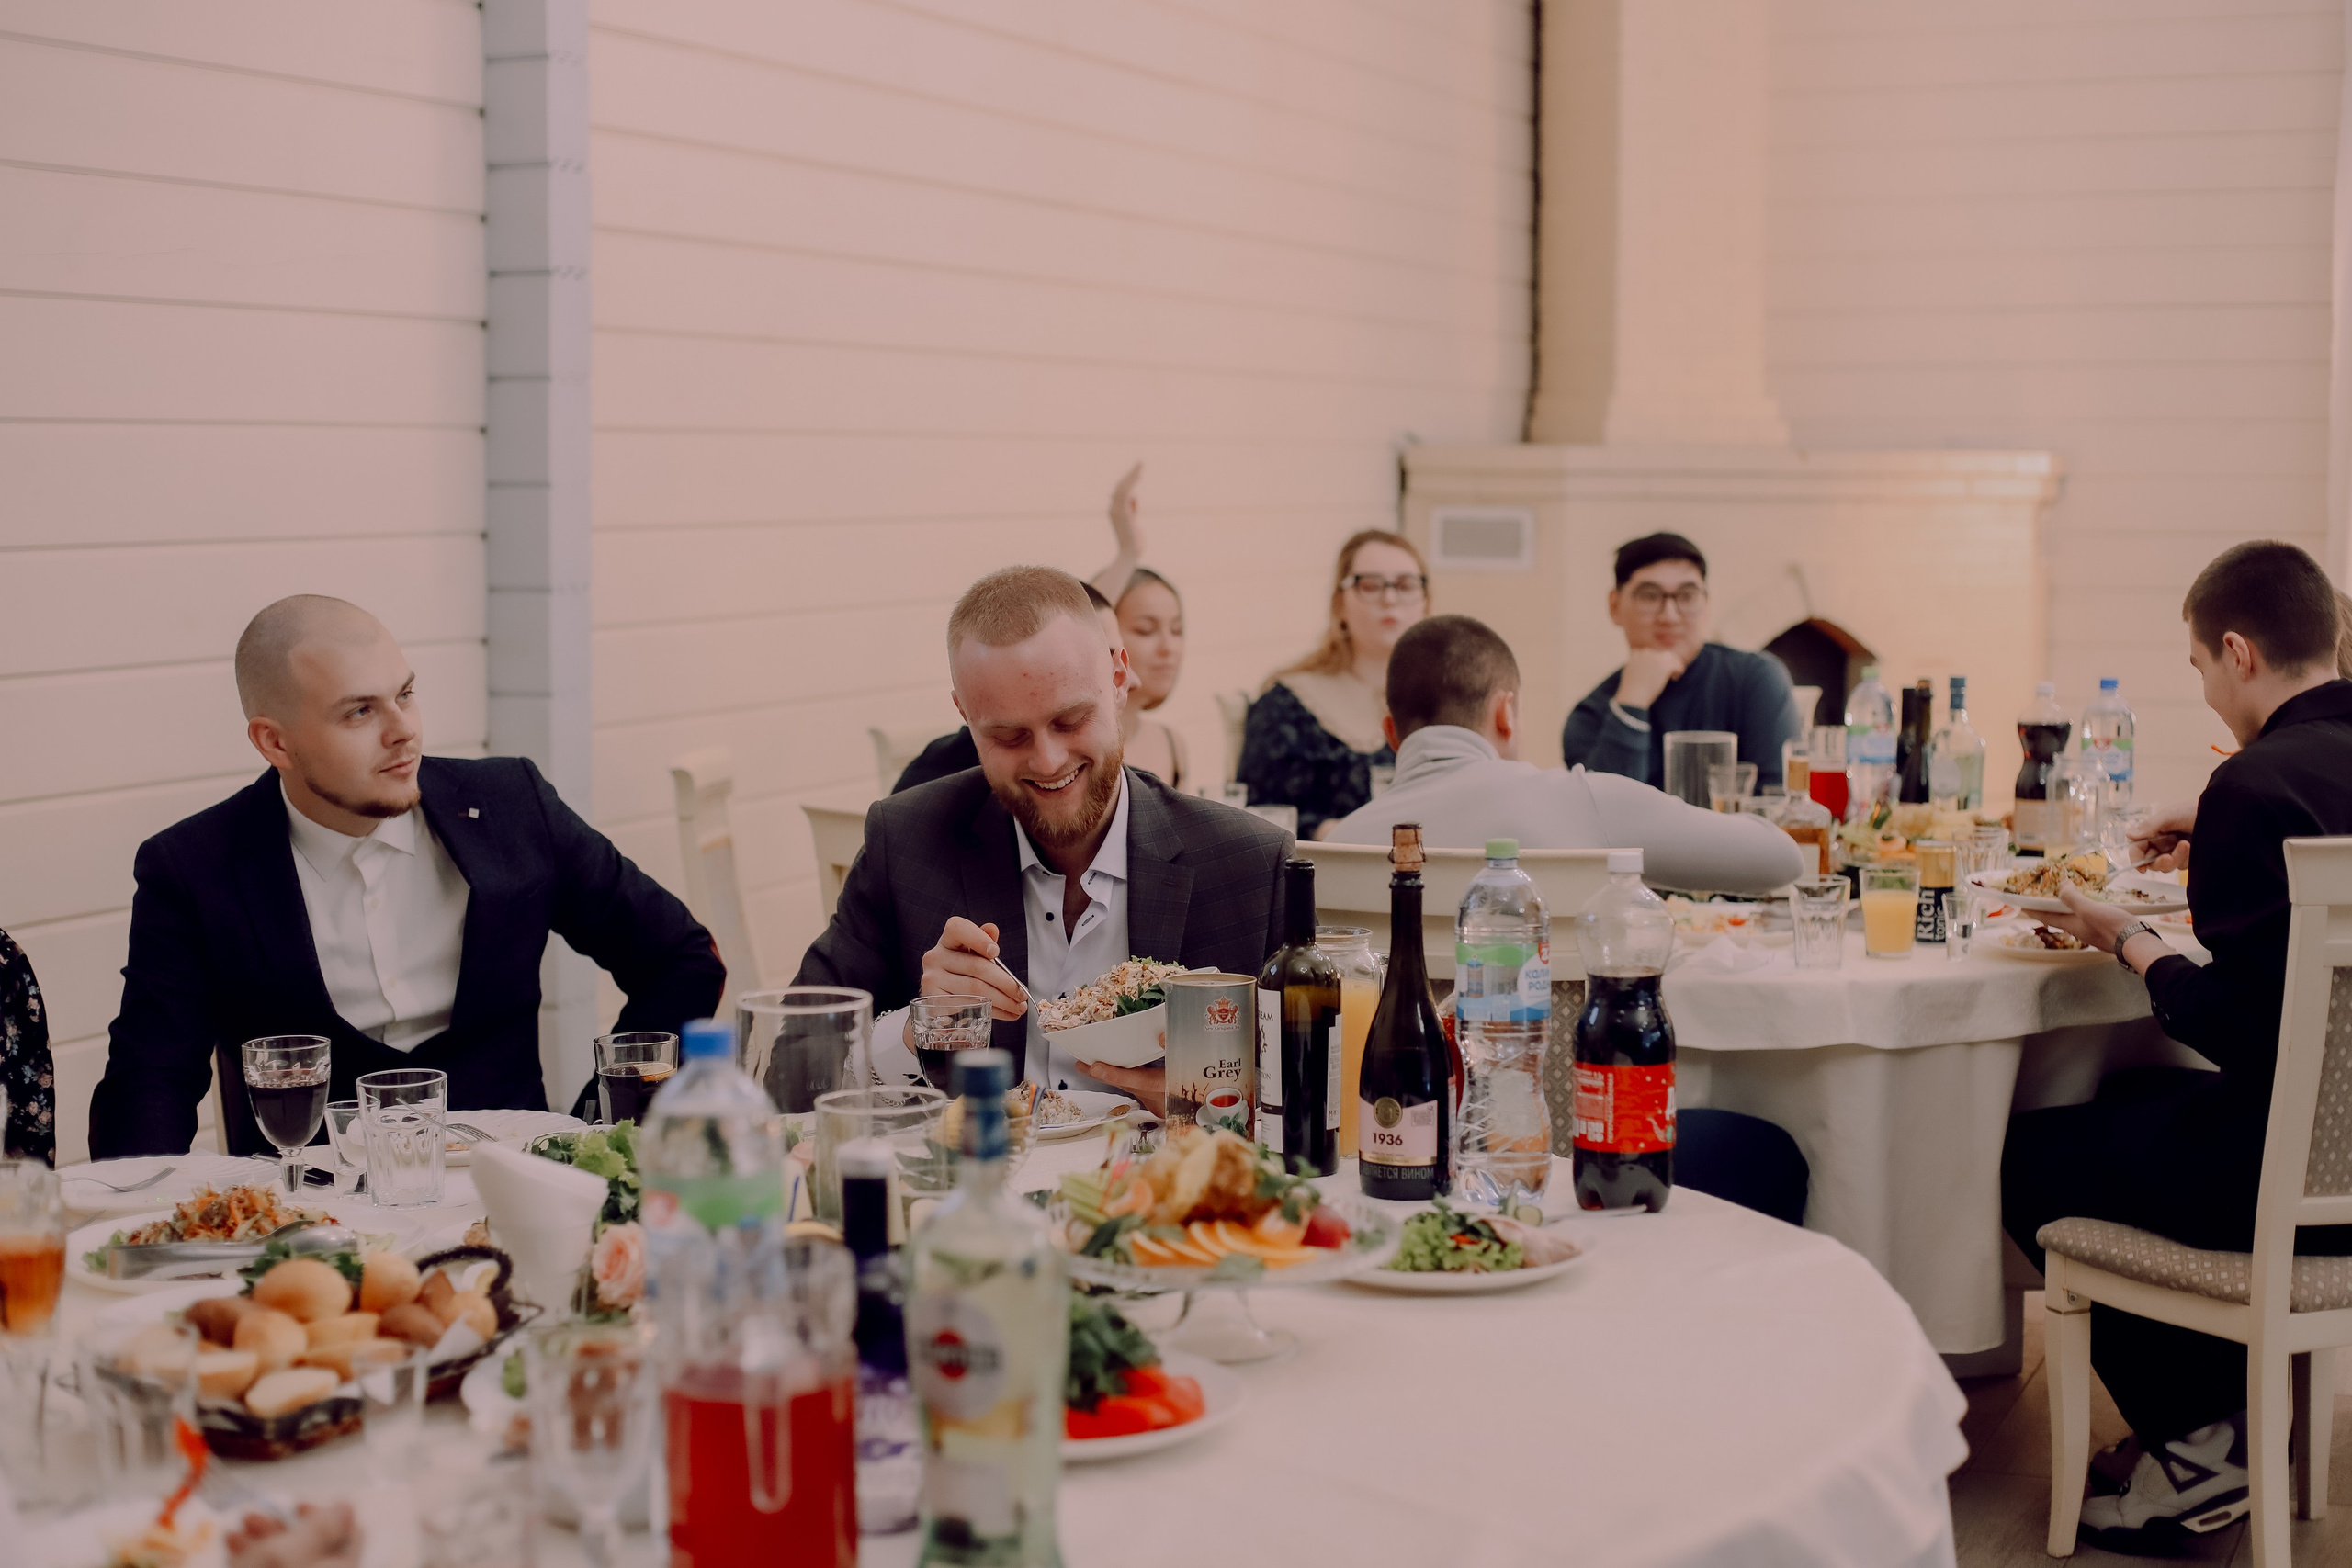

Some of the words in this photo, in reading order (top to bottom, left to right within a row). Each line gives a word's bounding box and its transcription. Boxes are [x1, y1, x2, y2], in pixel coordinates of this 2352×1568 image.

[1917, 890, 1935, 939] Rich
[1528, 980, 1550, 991] РОД
[1259, 1010, 1273, 1021] EAM
[1219, 1058, 1241, 1068] Earl
[1203, 1066, 1241, 1082] Grey
[1373, 1132, 1403, 1145] 1936
[1401, 1167, 1434, 1180] ВИНОМ
